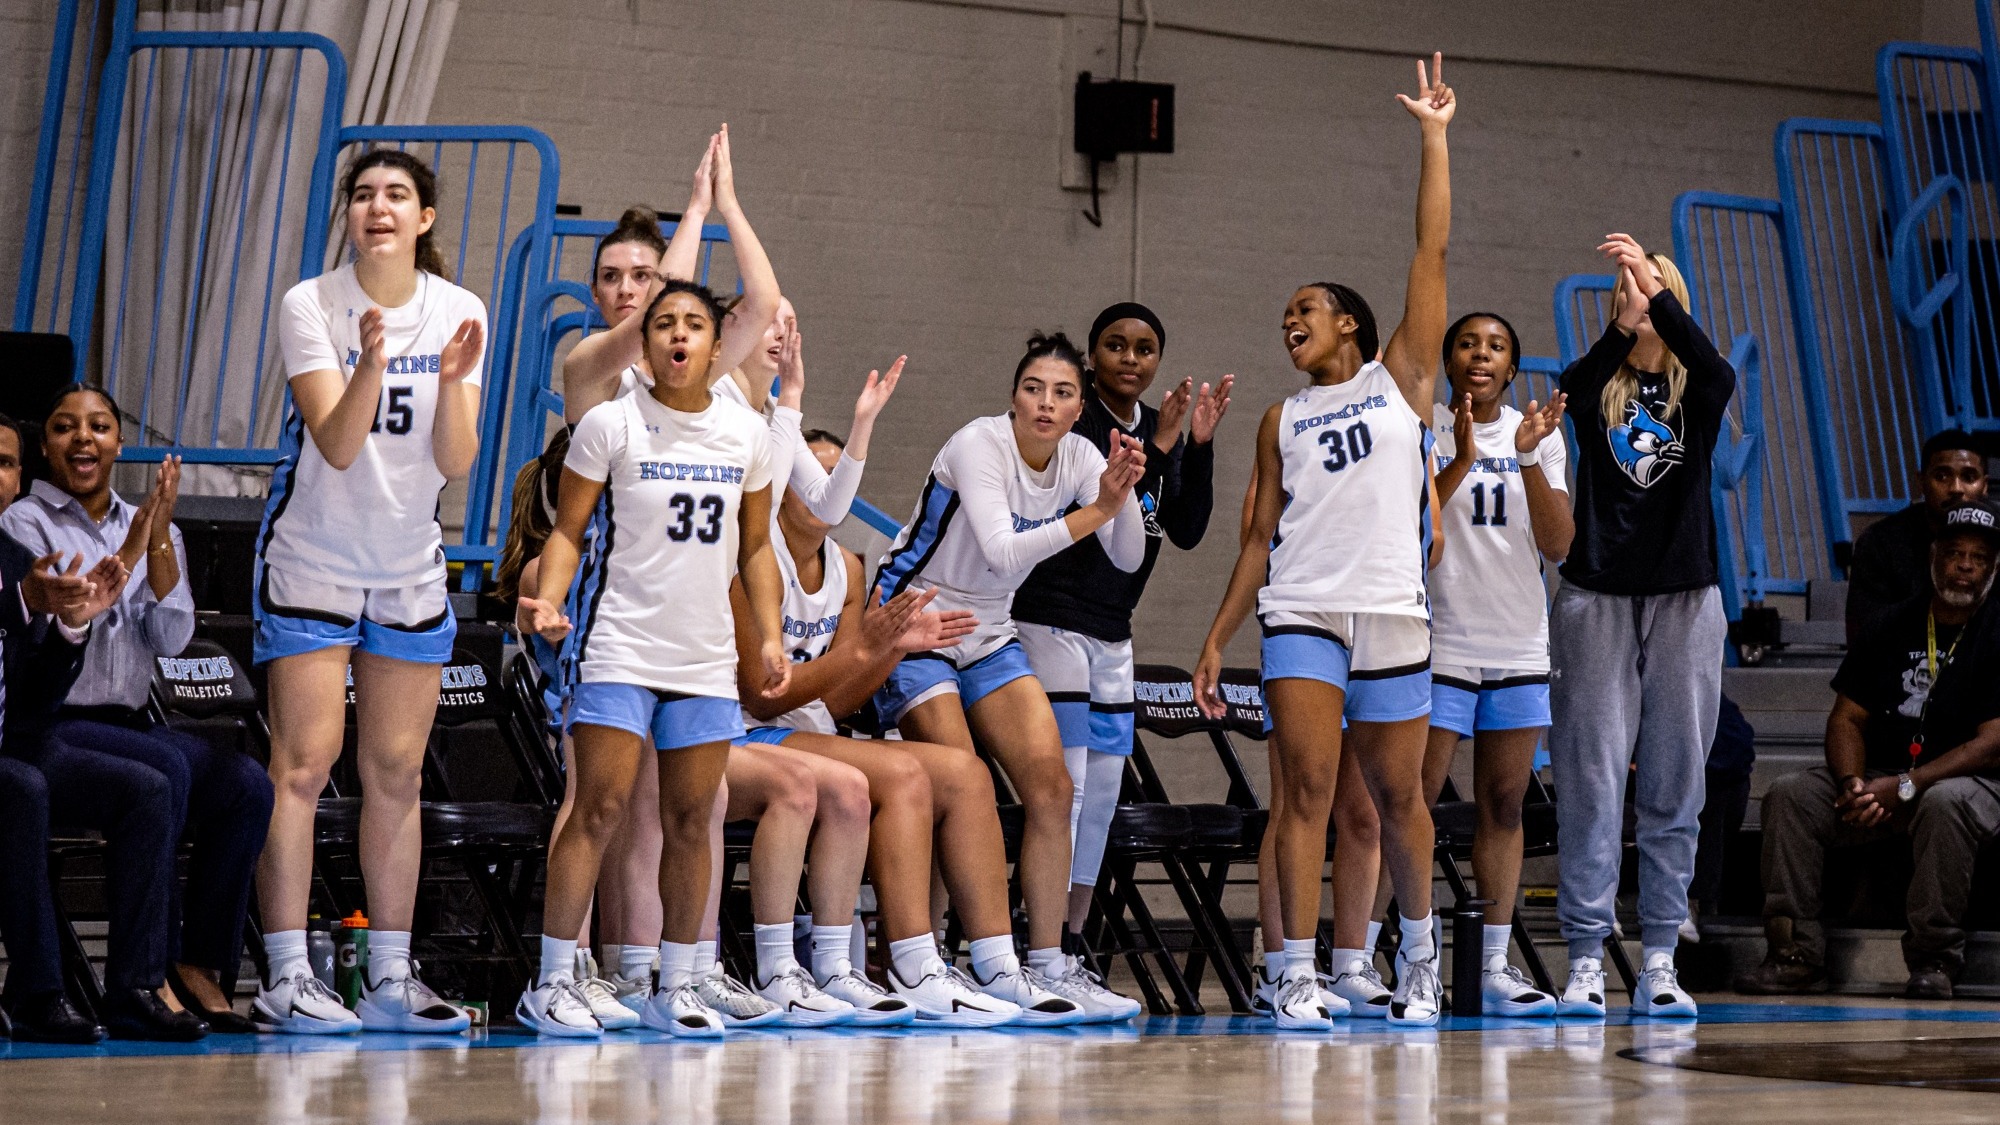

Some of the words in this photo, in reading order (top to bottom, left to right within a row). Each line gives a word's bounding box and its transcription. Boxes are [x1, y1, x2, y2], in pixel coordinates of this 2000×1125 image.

[346, 347, 441, 374] HKINS
[1293, 395, 1387, 437] HOPKINS
[1317, 420, 1372, 473] 30
[640, 462, 745, 484] HOPKINS
[1437, 456, 1520, 473] HPKIN
[1470, 482, 1507, 526] 11
[667, 492, 725, 544] 33
[1909, 651, 1928, 660] TEA
[157, 656, 234, 680] HOPKINS
[441, 664, 488, 689] KINS
[174, 684, 233, 698] ATHLETICS
[437, 691, 486, 706] HLETICS
[1134, 681, 1194, 703] HOPKIN
[1221, 683, 1262, 705] HOPK
[1146, 706, 1200, 719] ATHLETICS
[1236, 708, 1264, 720] ATHLE
